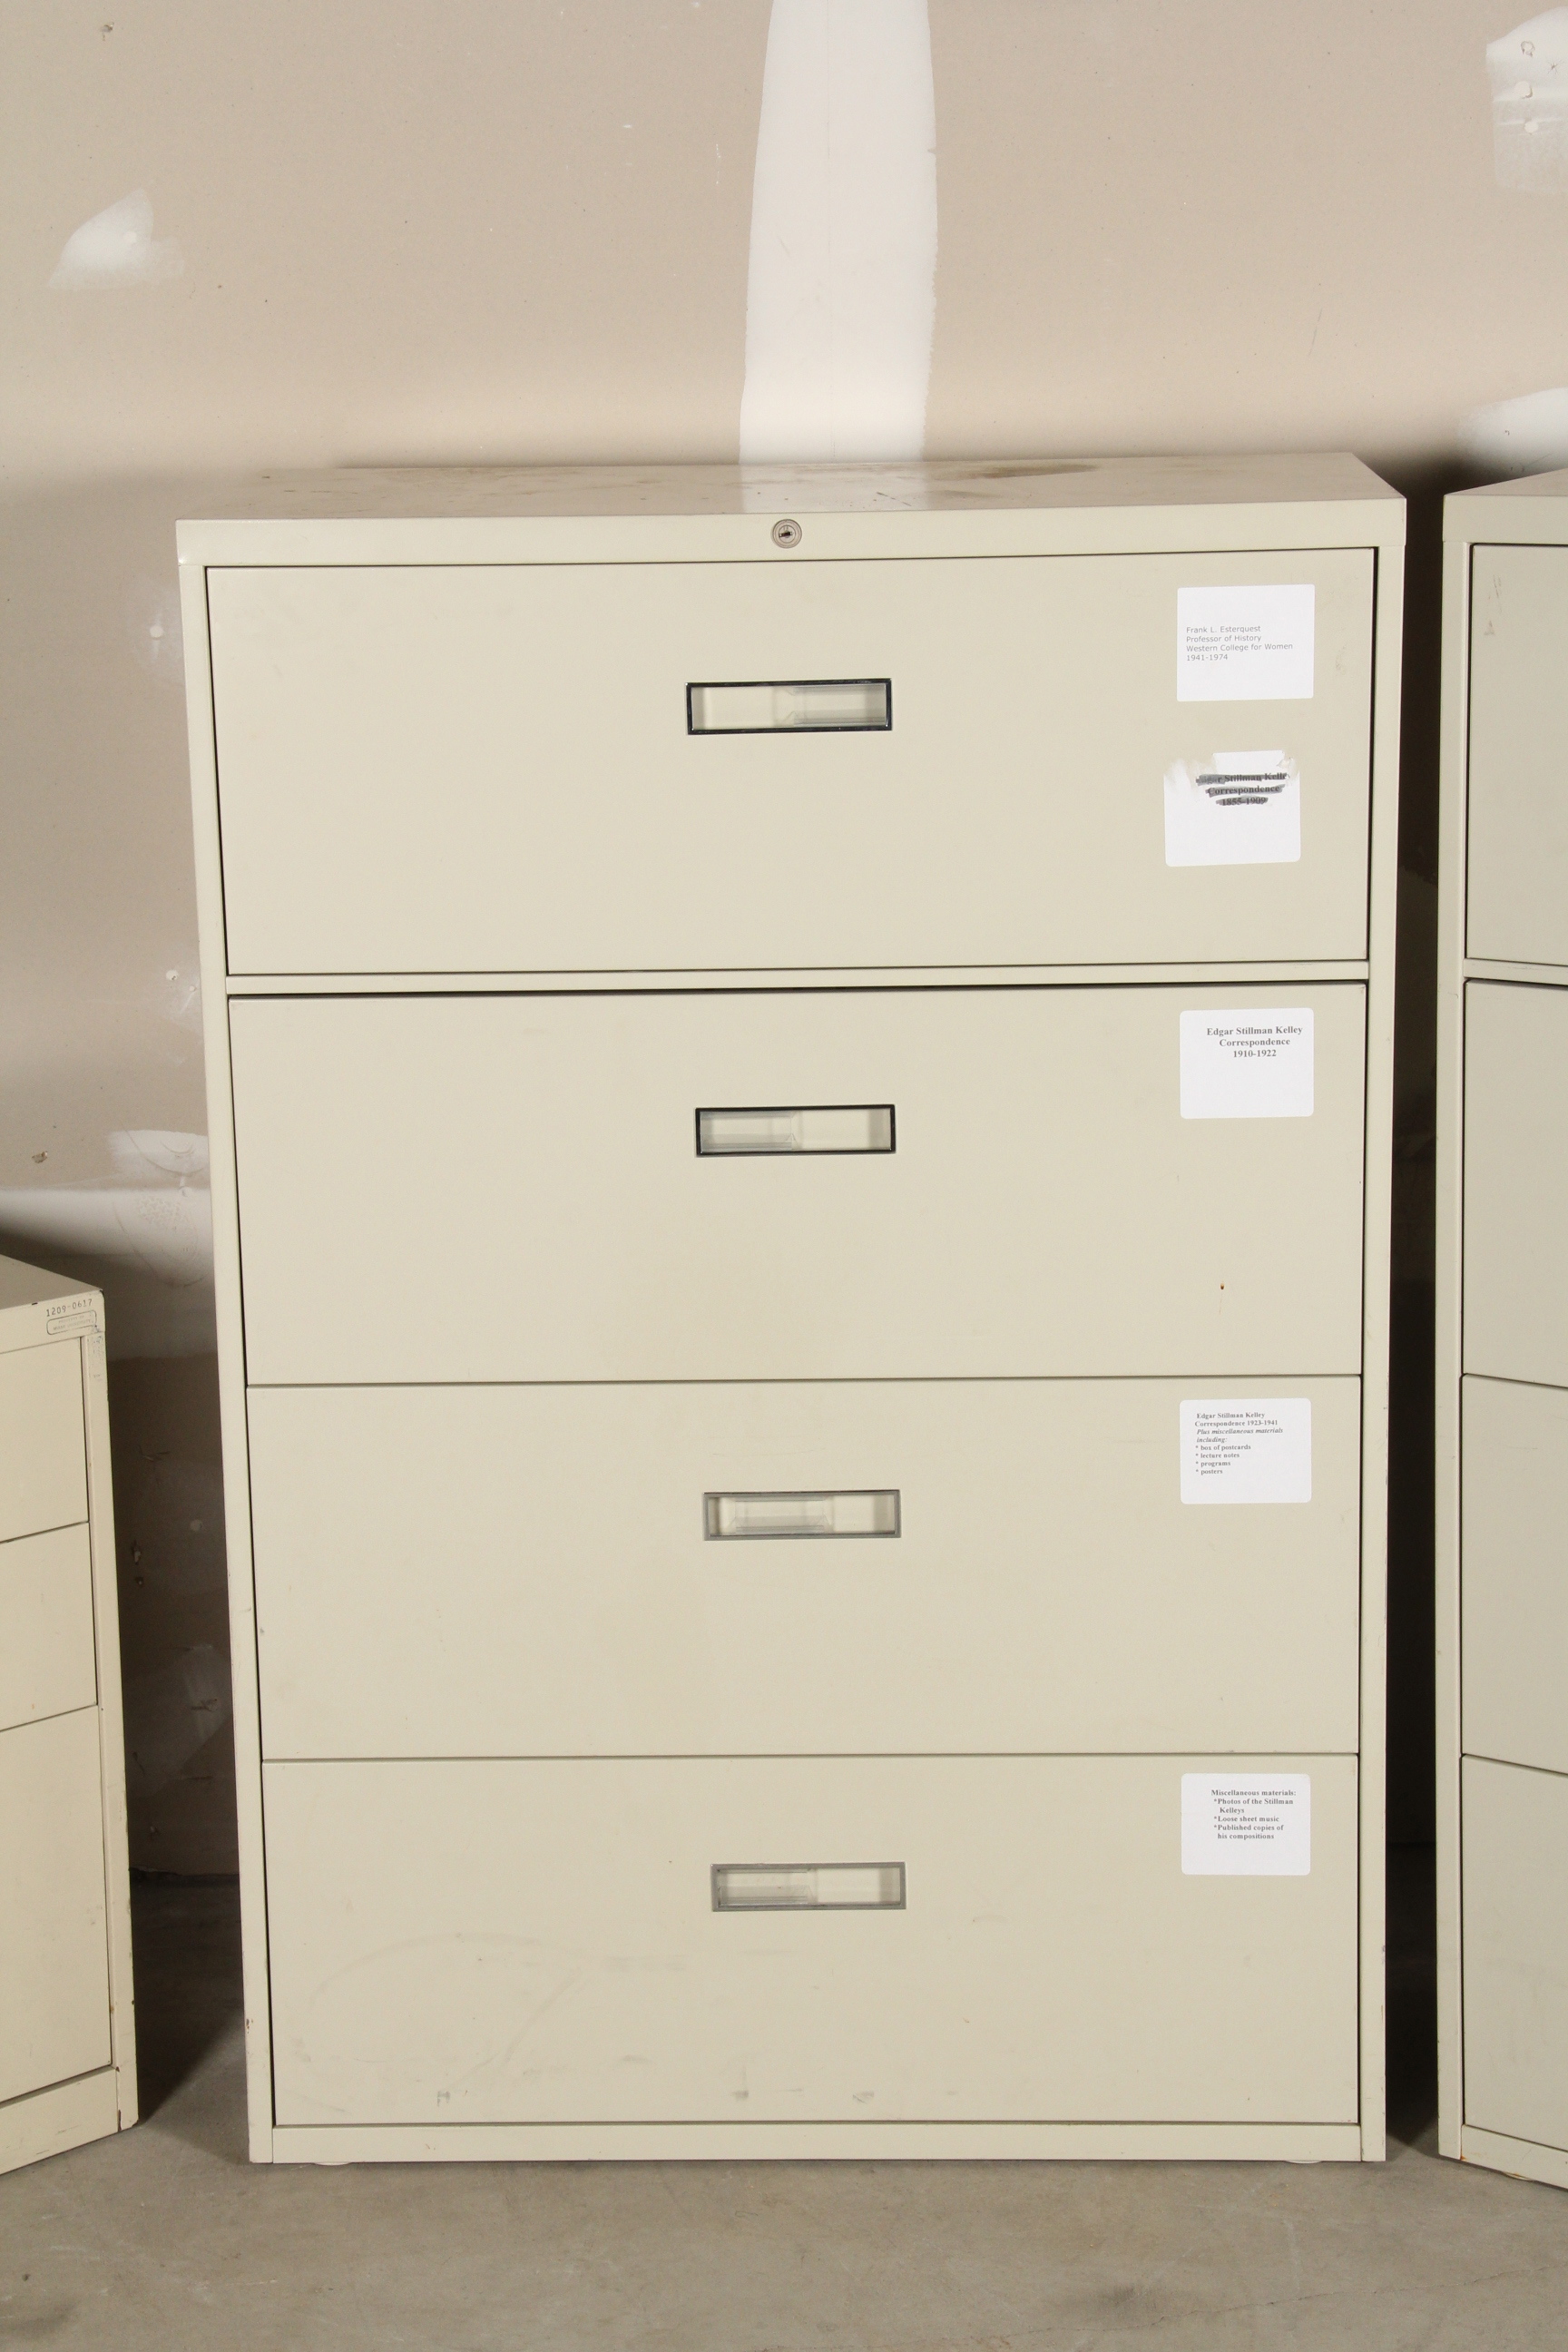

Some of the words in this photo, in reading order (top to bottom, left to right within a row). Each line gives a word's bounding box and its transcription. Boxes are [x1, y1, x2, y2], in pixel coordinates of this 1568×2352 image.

[1220, 625, 1261, 633] Esterquest
[1220, 644, 1249, 652] College
[1208, 785, 1280, 795] Correspondence
[1207, 1027, 1234, 1037] Edgar
[1276, 1026, 1303, 1034] Kelley
[1219, 1038, 1290, 1047] Correspondence
[1233, 1050, 1277, 1058] 1910-1922
[46, 1298, 93, 1317] 1209-0617
